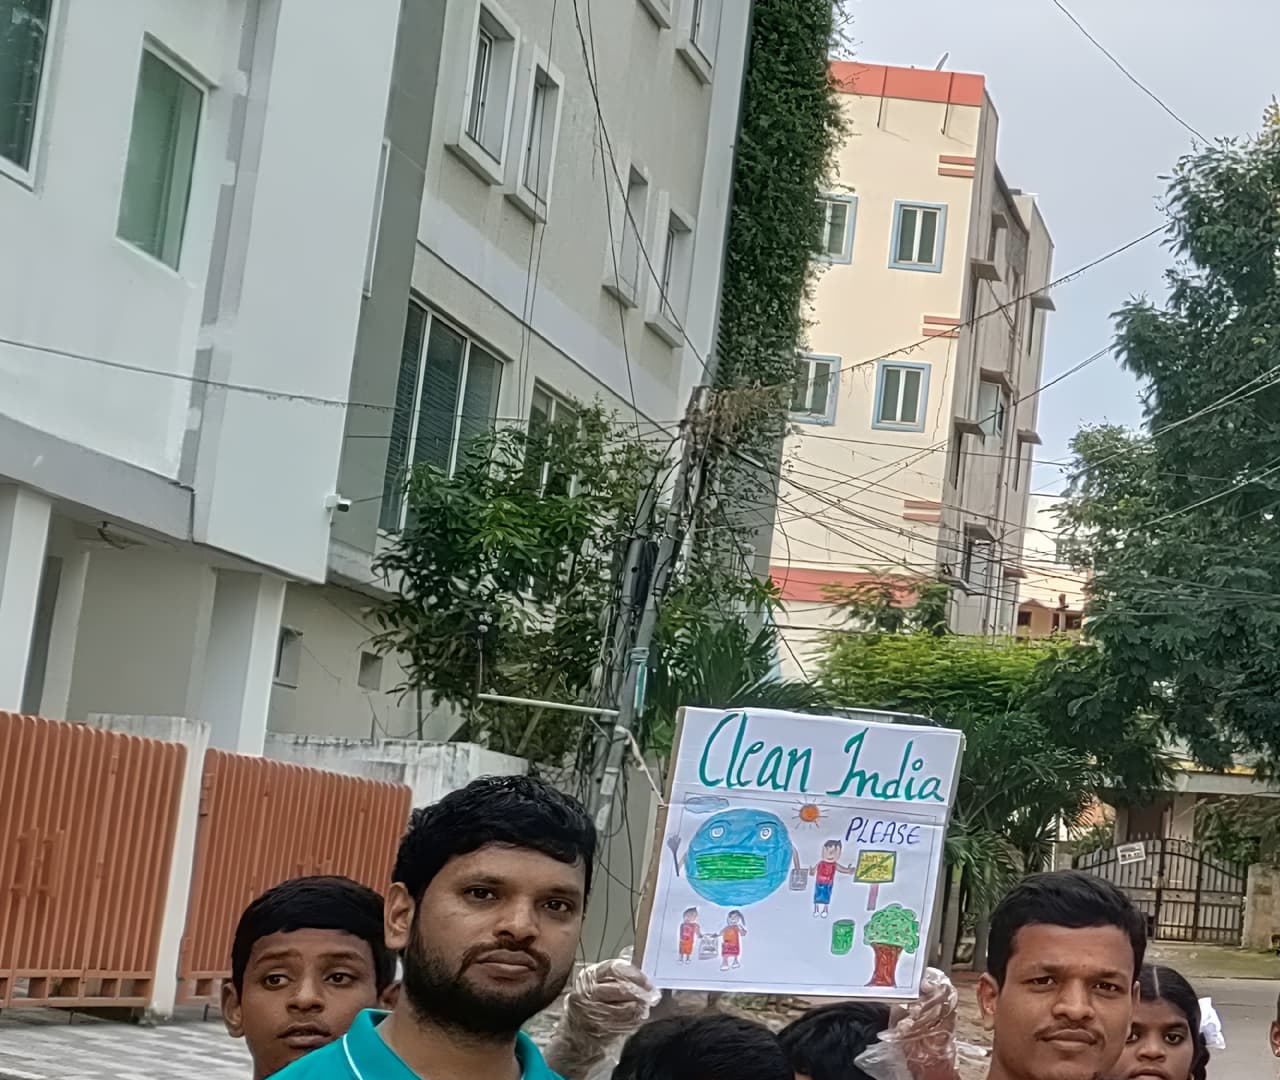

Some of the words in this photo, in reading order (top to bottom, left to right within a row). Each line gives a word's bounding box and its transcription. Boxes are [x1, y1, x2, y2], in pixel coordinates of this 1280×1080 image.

[698, 711, 814, 791] Clean
[826, 727, 946, 803] India
[846, 816, 922, 846] PLEASE
